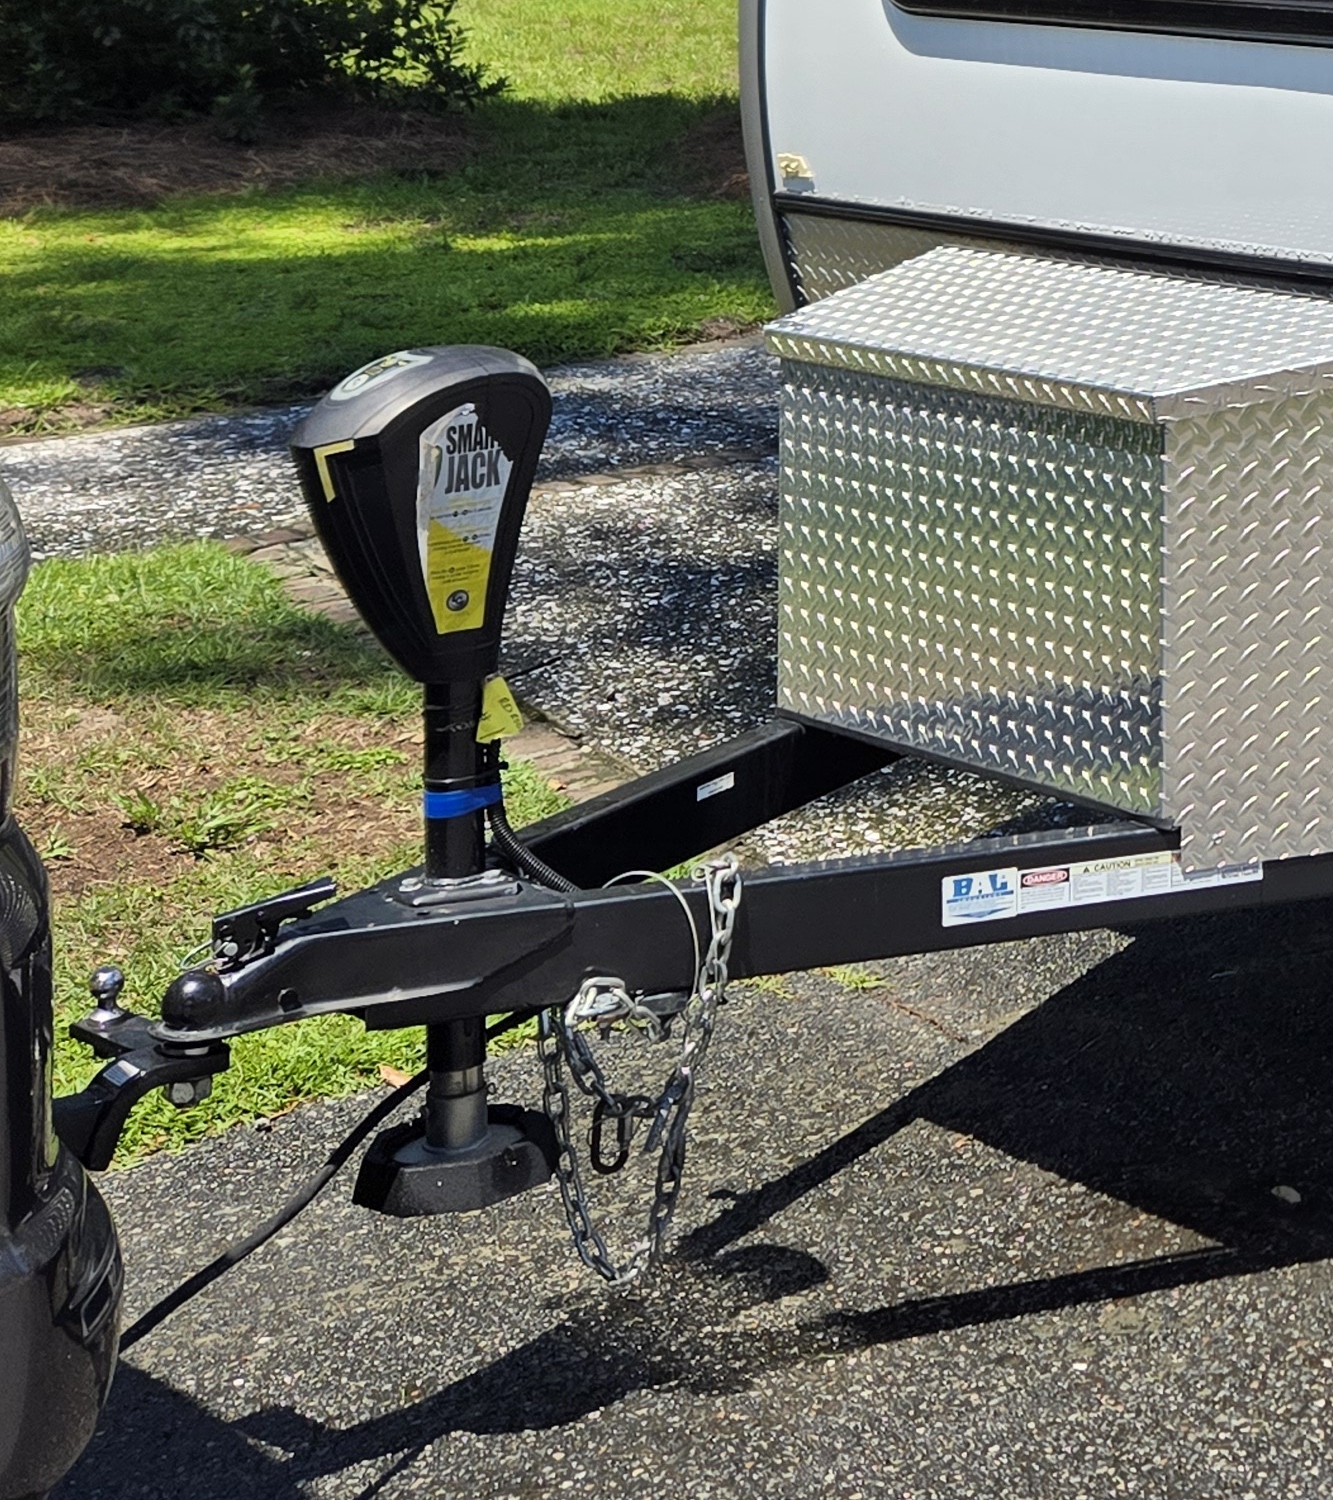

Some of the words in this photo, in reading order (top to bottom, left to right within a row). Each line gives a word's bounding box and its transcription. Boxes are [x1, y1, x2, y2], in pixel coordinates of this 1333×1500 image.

[446, 423, 500, 455] SMA
[444, 449, 501, 494] JACK
[1093, 860, 1131, 873] CAUTION
[952, 873, 1008, 898] BAL
